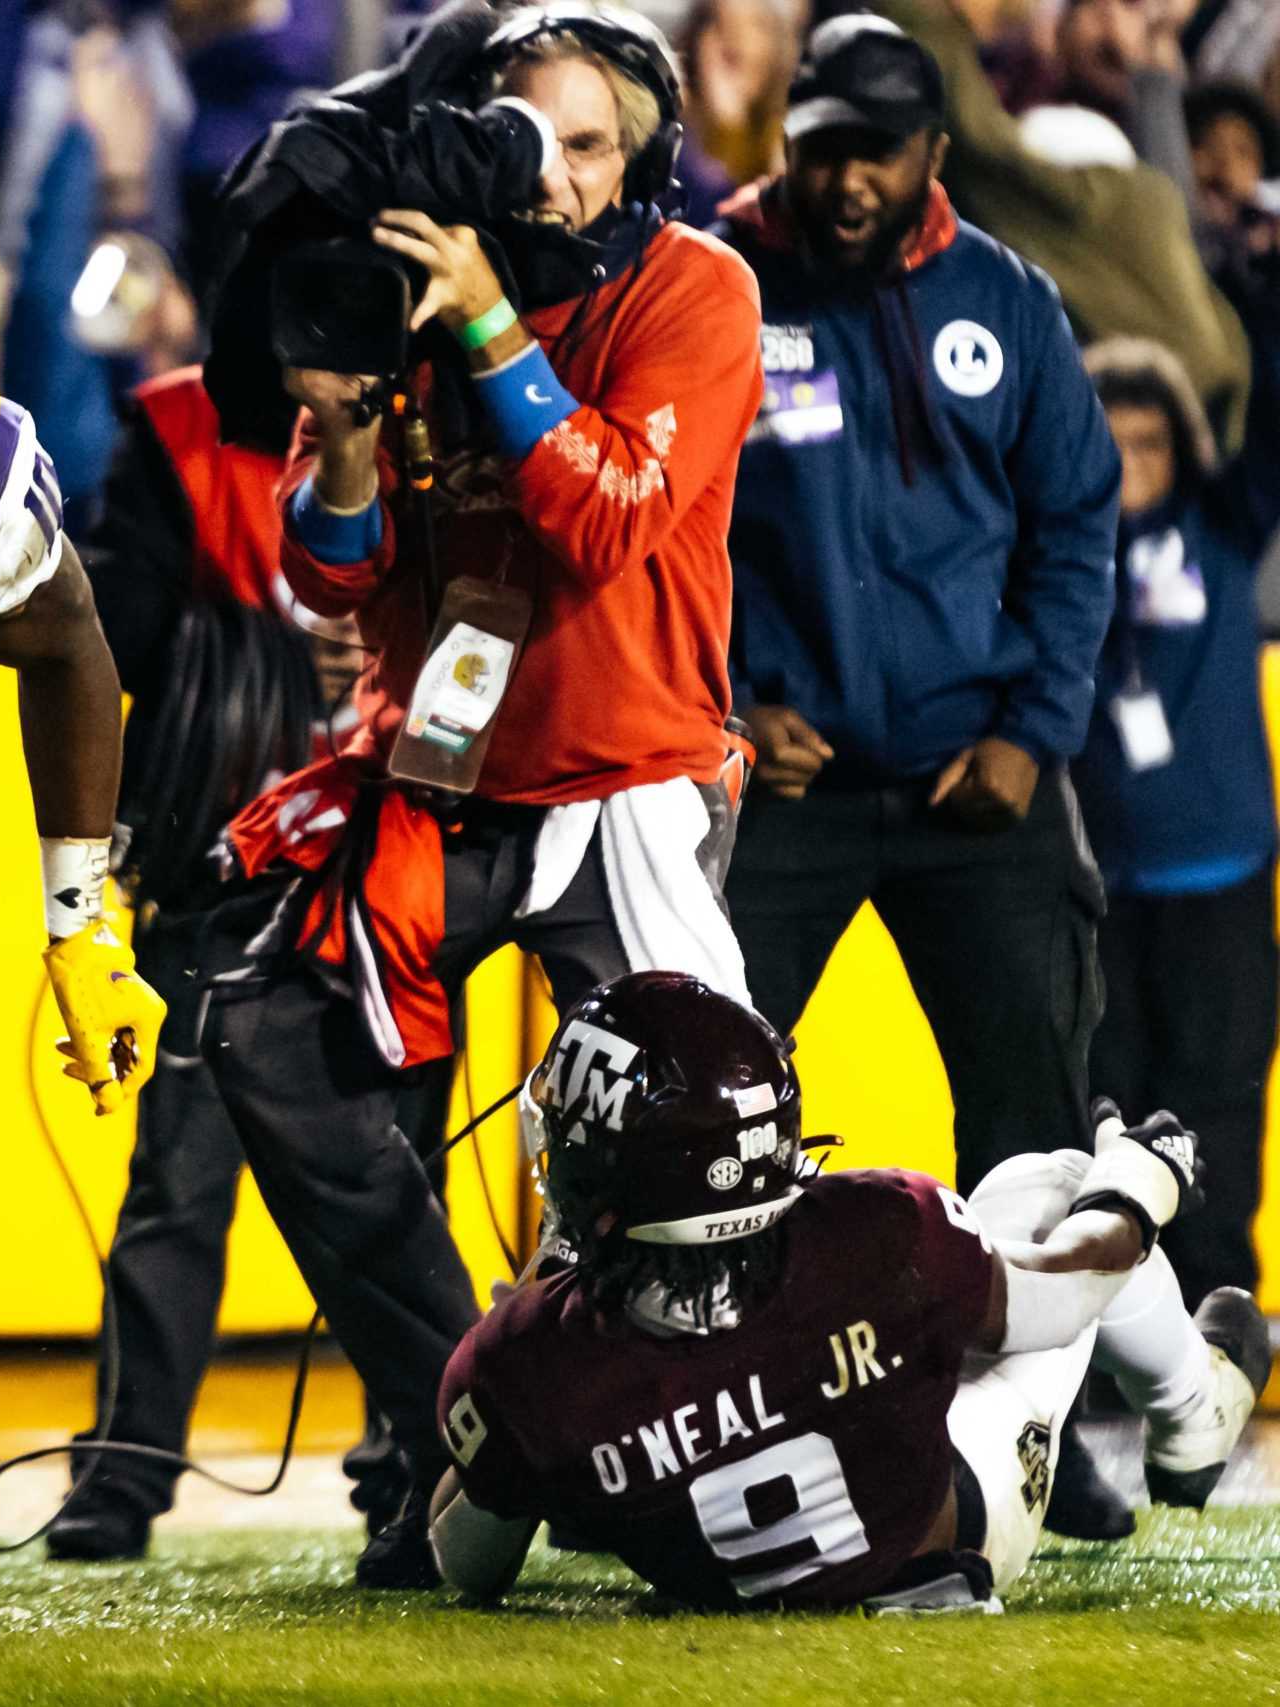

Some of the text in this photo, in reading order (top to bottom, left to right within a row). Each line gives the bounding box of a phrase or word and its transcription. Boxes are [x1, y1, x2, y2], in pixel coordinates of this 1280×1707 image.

[709, 1158, 741, 1189] SEC
[705, 1213, 763, 1239] TEXAS
[592, 1319, 904, 1494] O'NEAL JR.
[689, 1431, 871, 1598] 9
